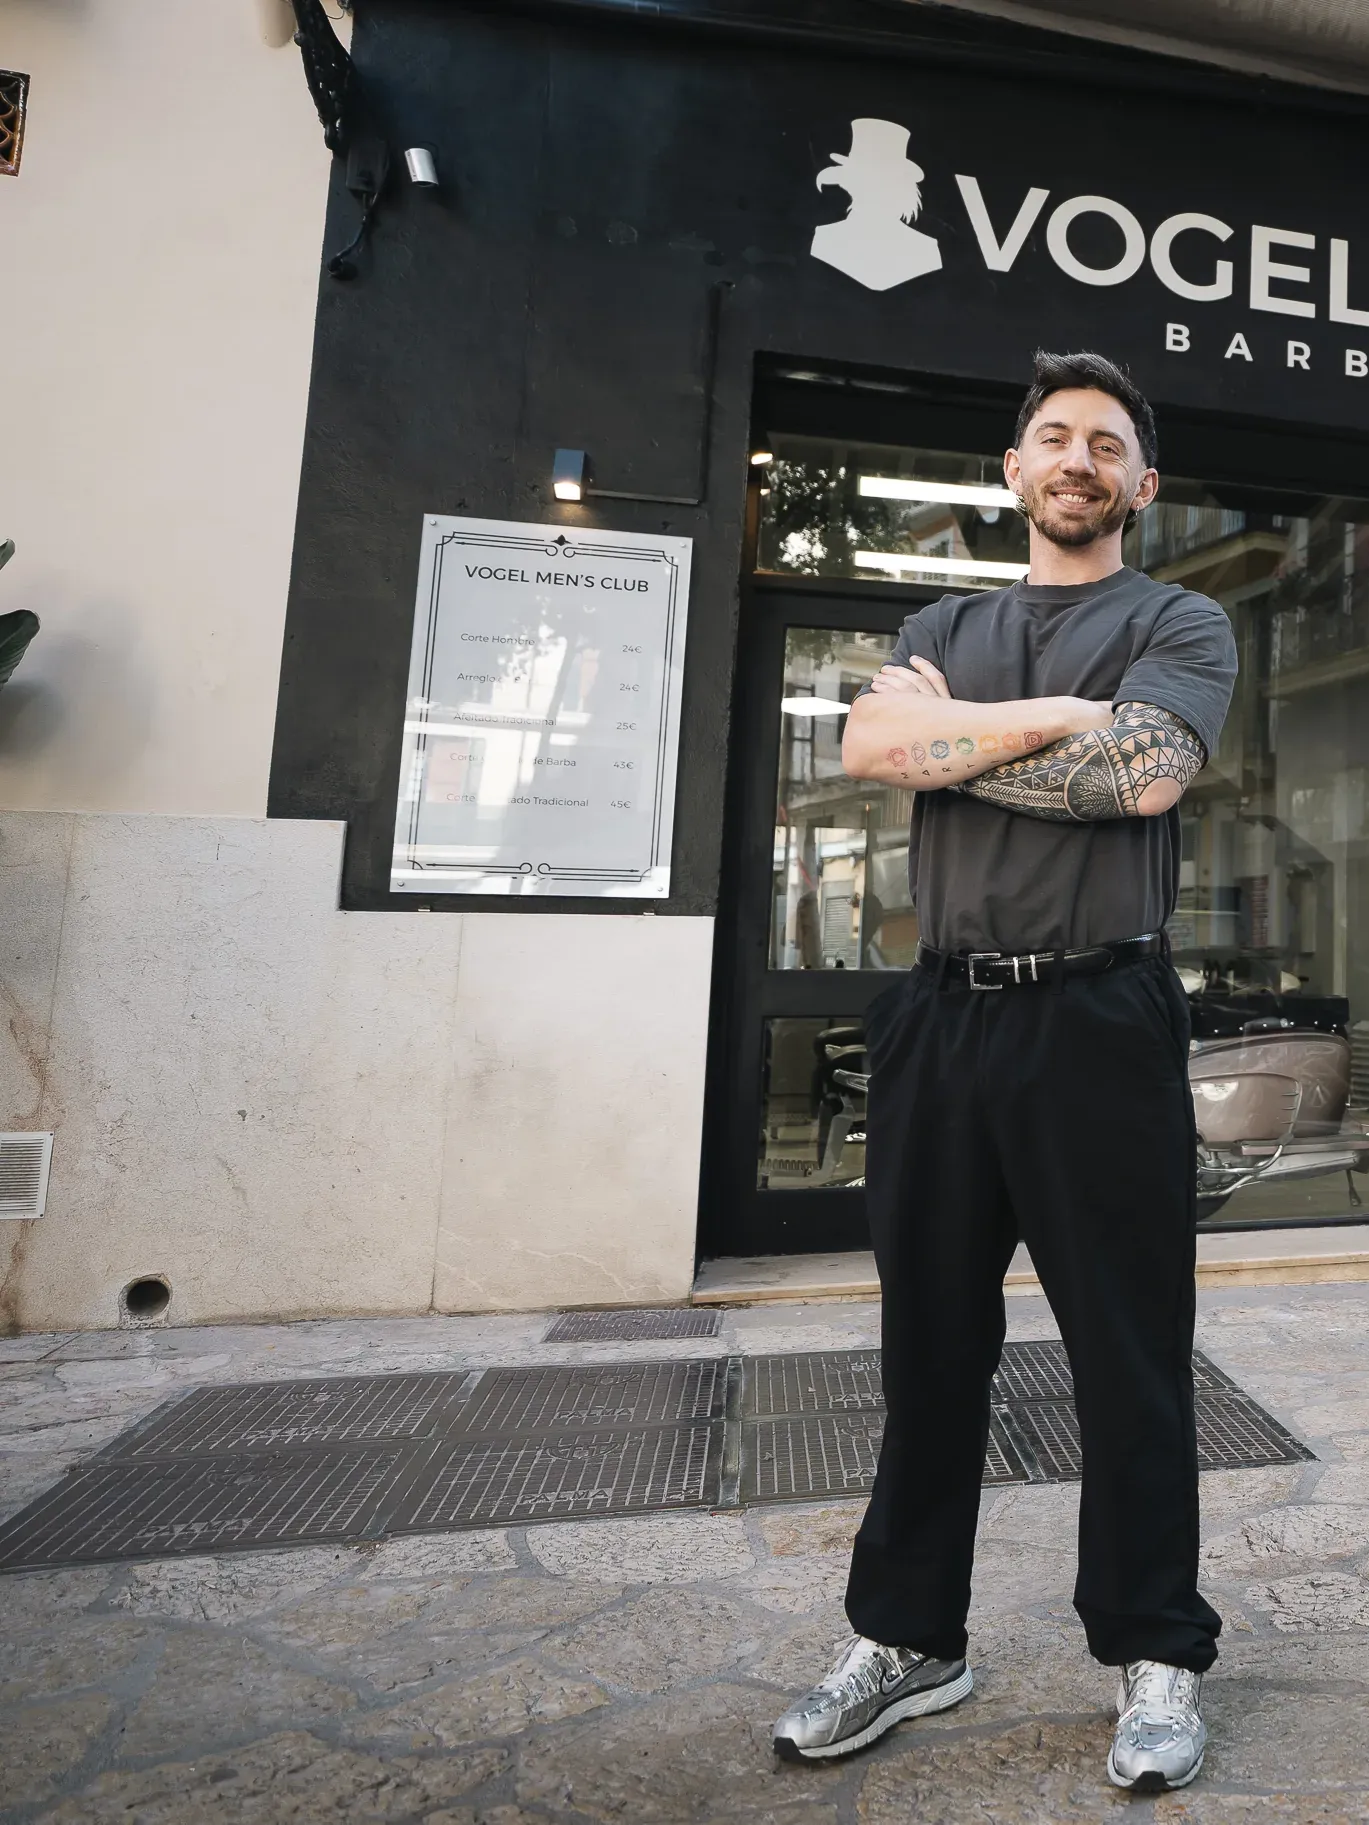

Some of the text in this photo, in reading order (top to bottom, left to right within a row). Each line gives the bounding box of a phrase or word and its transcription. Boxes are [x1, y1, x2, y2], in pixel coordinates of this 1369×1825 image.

[465, 565, 649, 592] VOGEL MEN'S CLUB
[460, 633, 642, 653] Corte Hombre 24€
[457, 672, 496, 684] Arreglo
[619, 683, 640, 692] 24€
[453, 712, 499, 723] Afeitado
[616, 721, 636, 731] 25€
[546, 757, 577, 767] Barba
[613, 761, 634, 770] 43€
[446, 793, 475, 803] Corte
[533, 796, 589, 807] Tradicional
[610, 800, 631, 809] 45€
[556, 1407, 634, 1419] PALMA
[521, 1489, 610, 1504] PALMA
